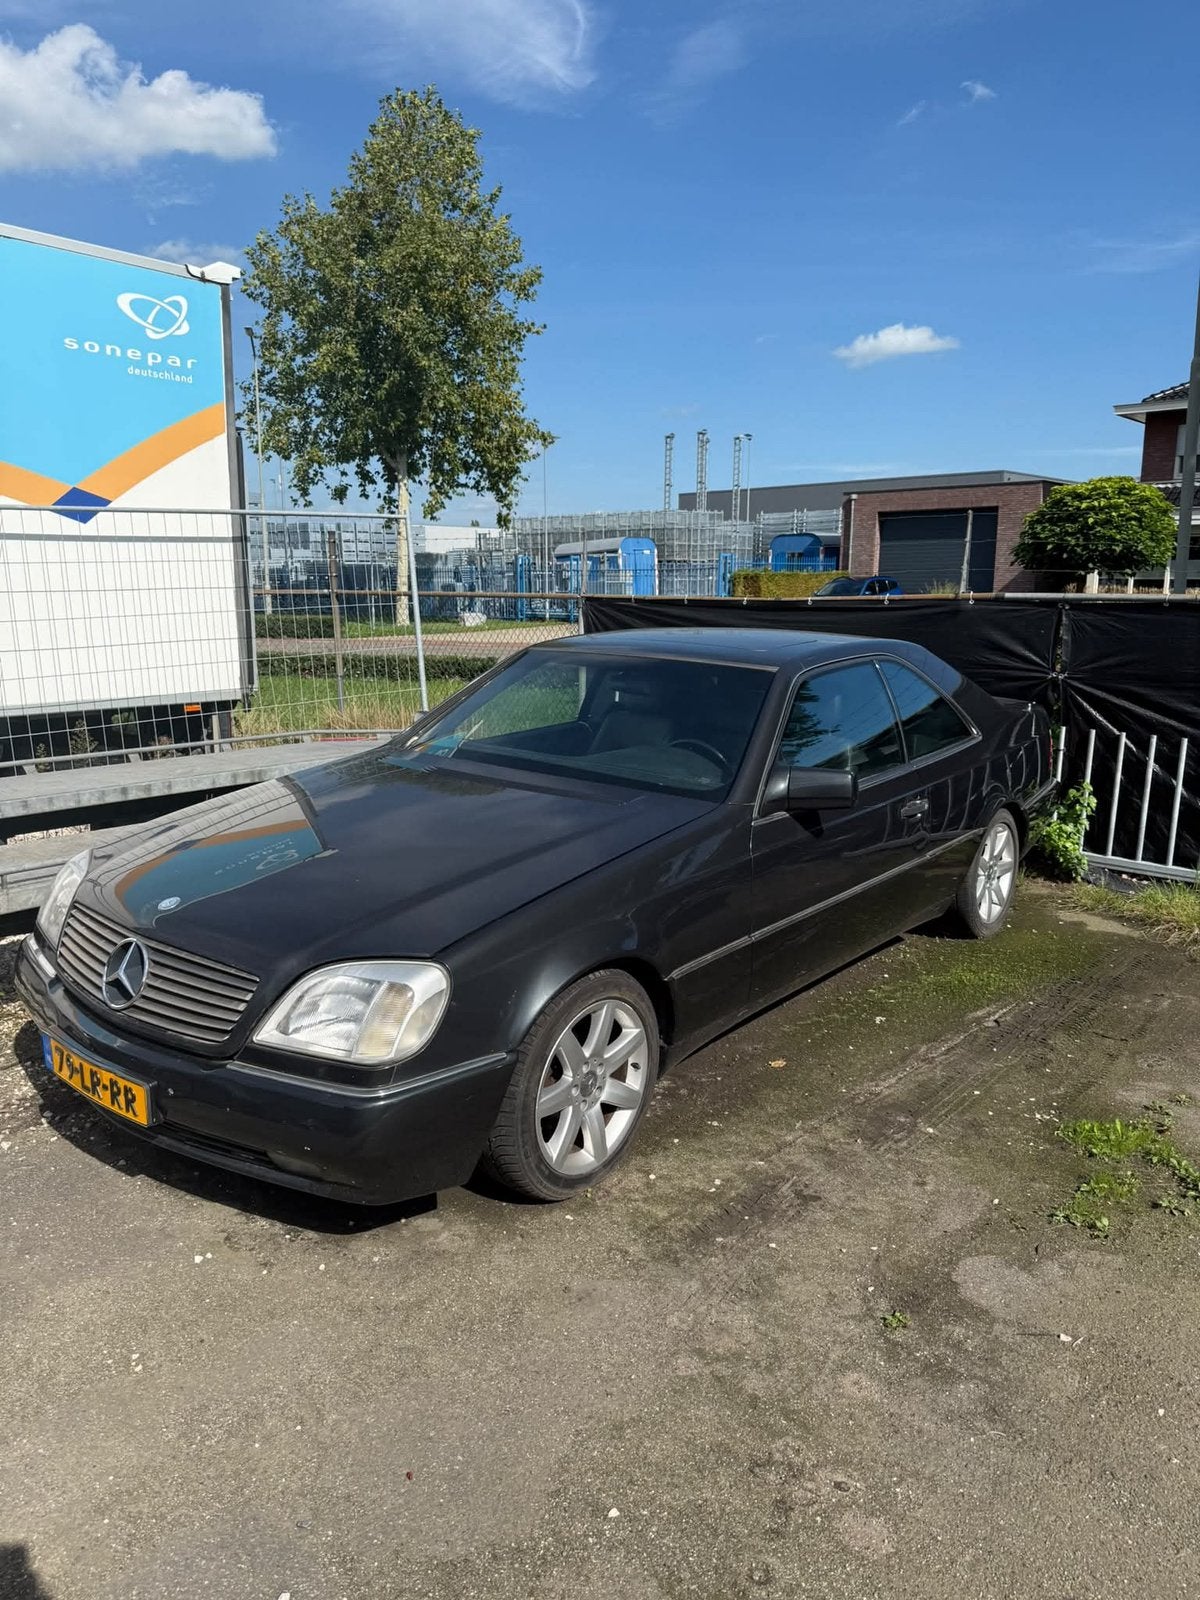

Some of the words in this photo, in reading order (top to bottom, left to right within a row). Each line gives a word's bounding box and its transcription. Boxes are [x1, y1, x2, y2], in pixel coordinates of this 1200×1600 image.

[63, 336, 198, 369] sonepar
[127, 365, 193, 384] deutschland
[54, 1045, 139, 1117] 79-LR-RR
